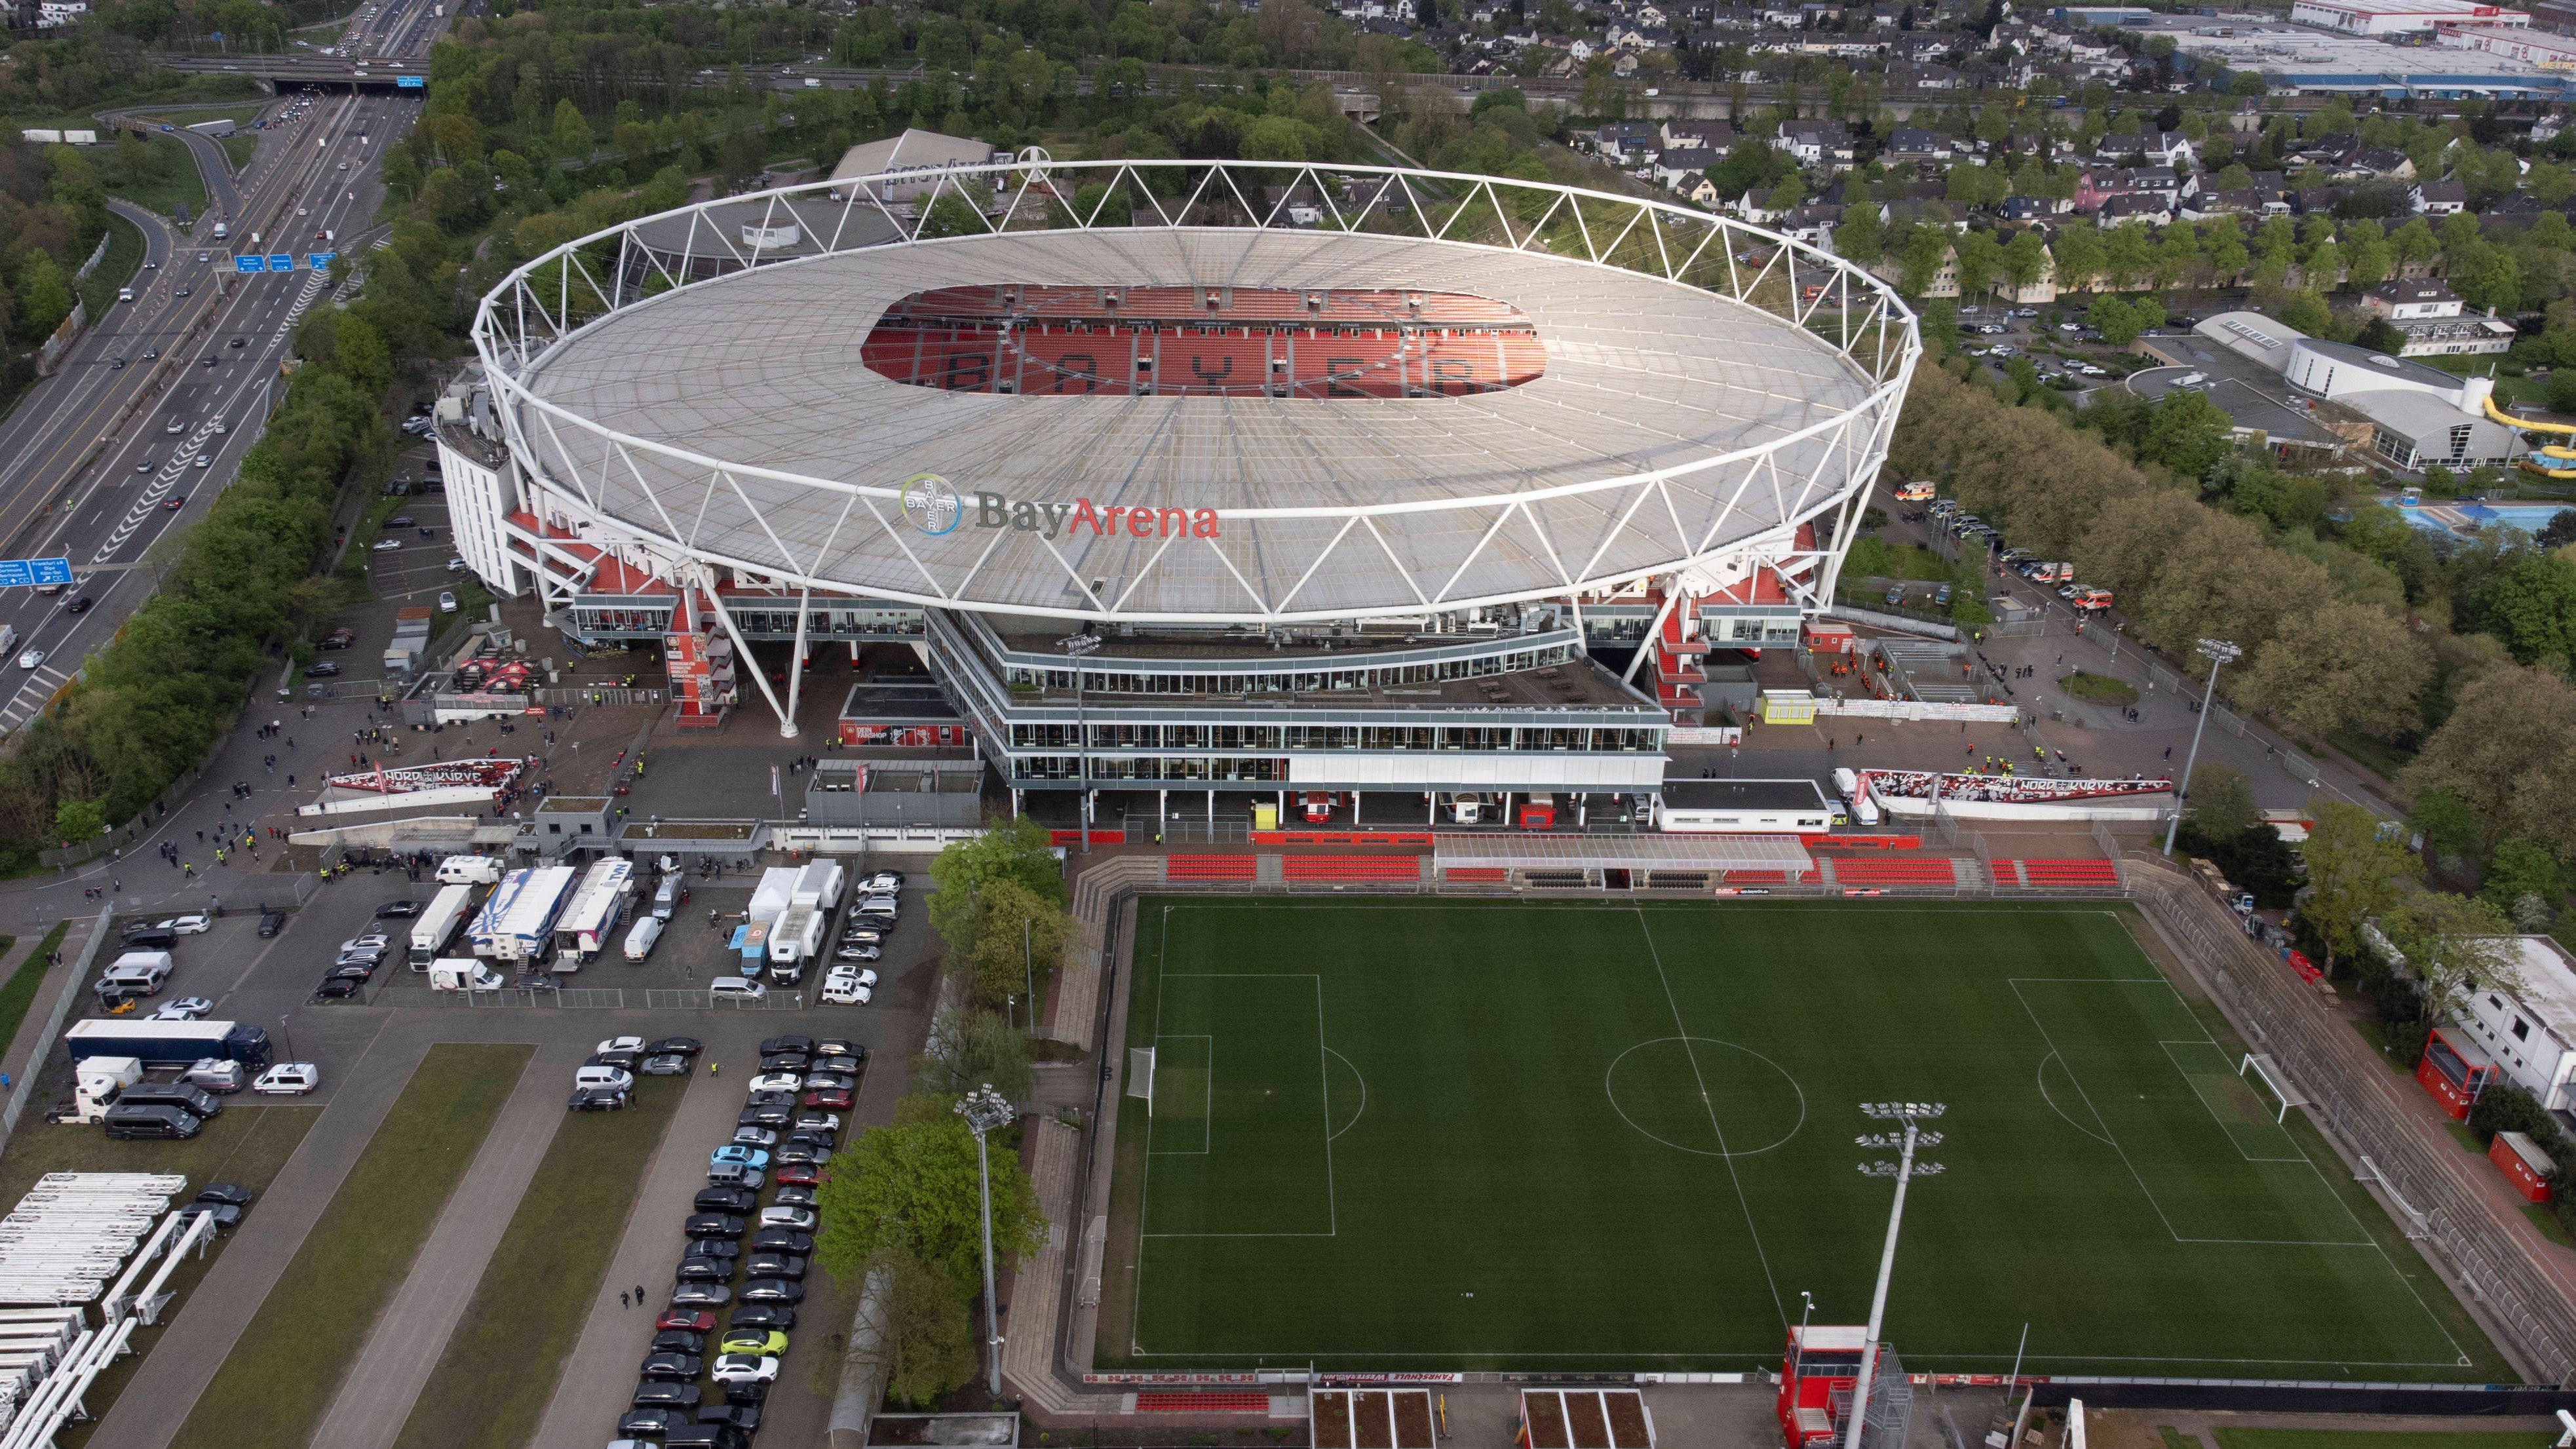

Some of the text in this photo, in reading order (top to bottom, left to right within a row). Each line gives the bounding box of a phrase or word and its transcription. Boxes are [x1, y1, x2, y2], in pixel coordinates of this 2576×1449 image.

[906, 499, 955, 512] BAYER
[973, 490, 1220, 540] BayArena
[385, 771, 420, 782] NORD
[436, 771, 483, 782] KURVE
[2021, 781, 2056, 791] NORD
[1393, 1373, 1456, 1381] FAHRSCHULE
